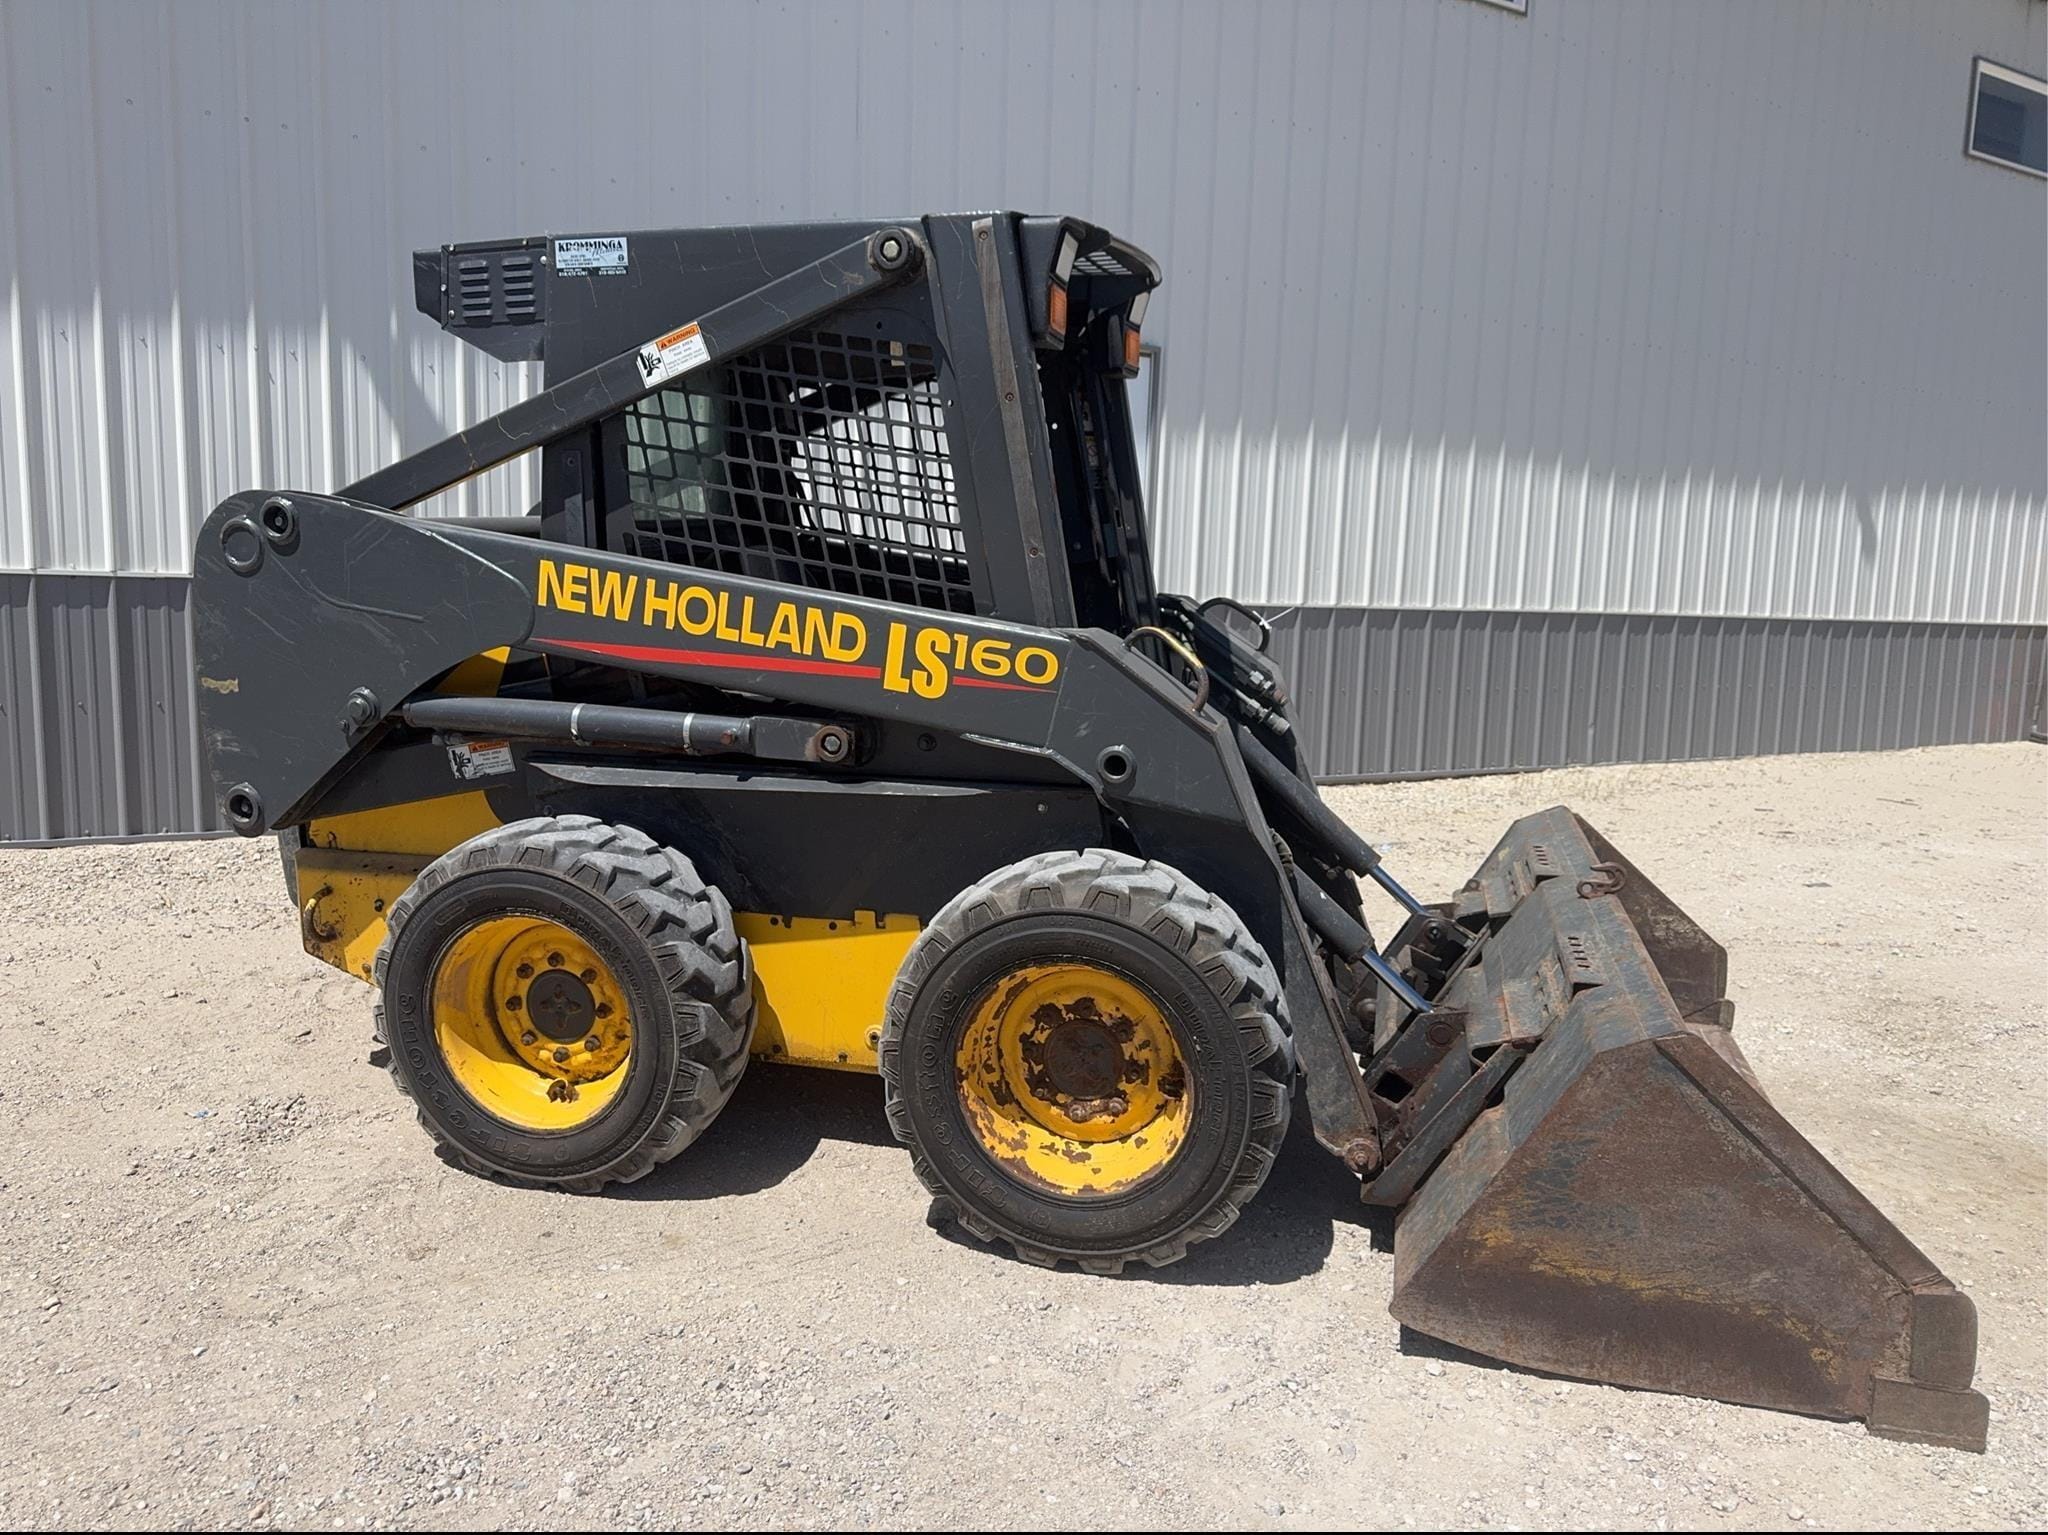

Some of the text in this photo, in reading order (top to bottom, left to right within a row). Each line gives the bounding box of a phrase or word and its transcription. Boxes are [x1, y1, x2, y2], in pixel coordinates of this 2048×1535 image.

[558, 240, 623, 253] KROMMINGA
[667, 327, 696, 344] WARNING
[537, 559, 638, 623] NEW
[643, 578, 867, 663] HOLLAND
